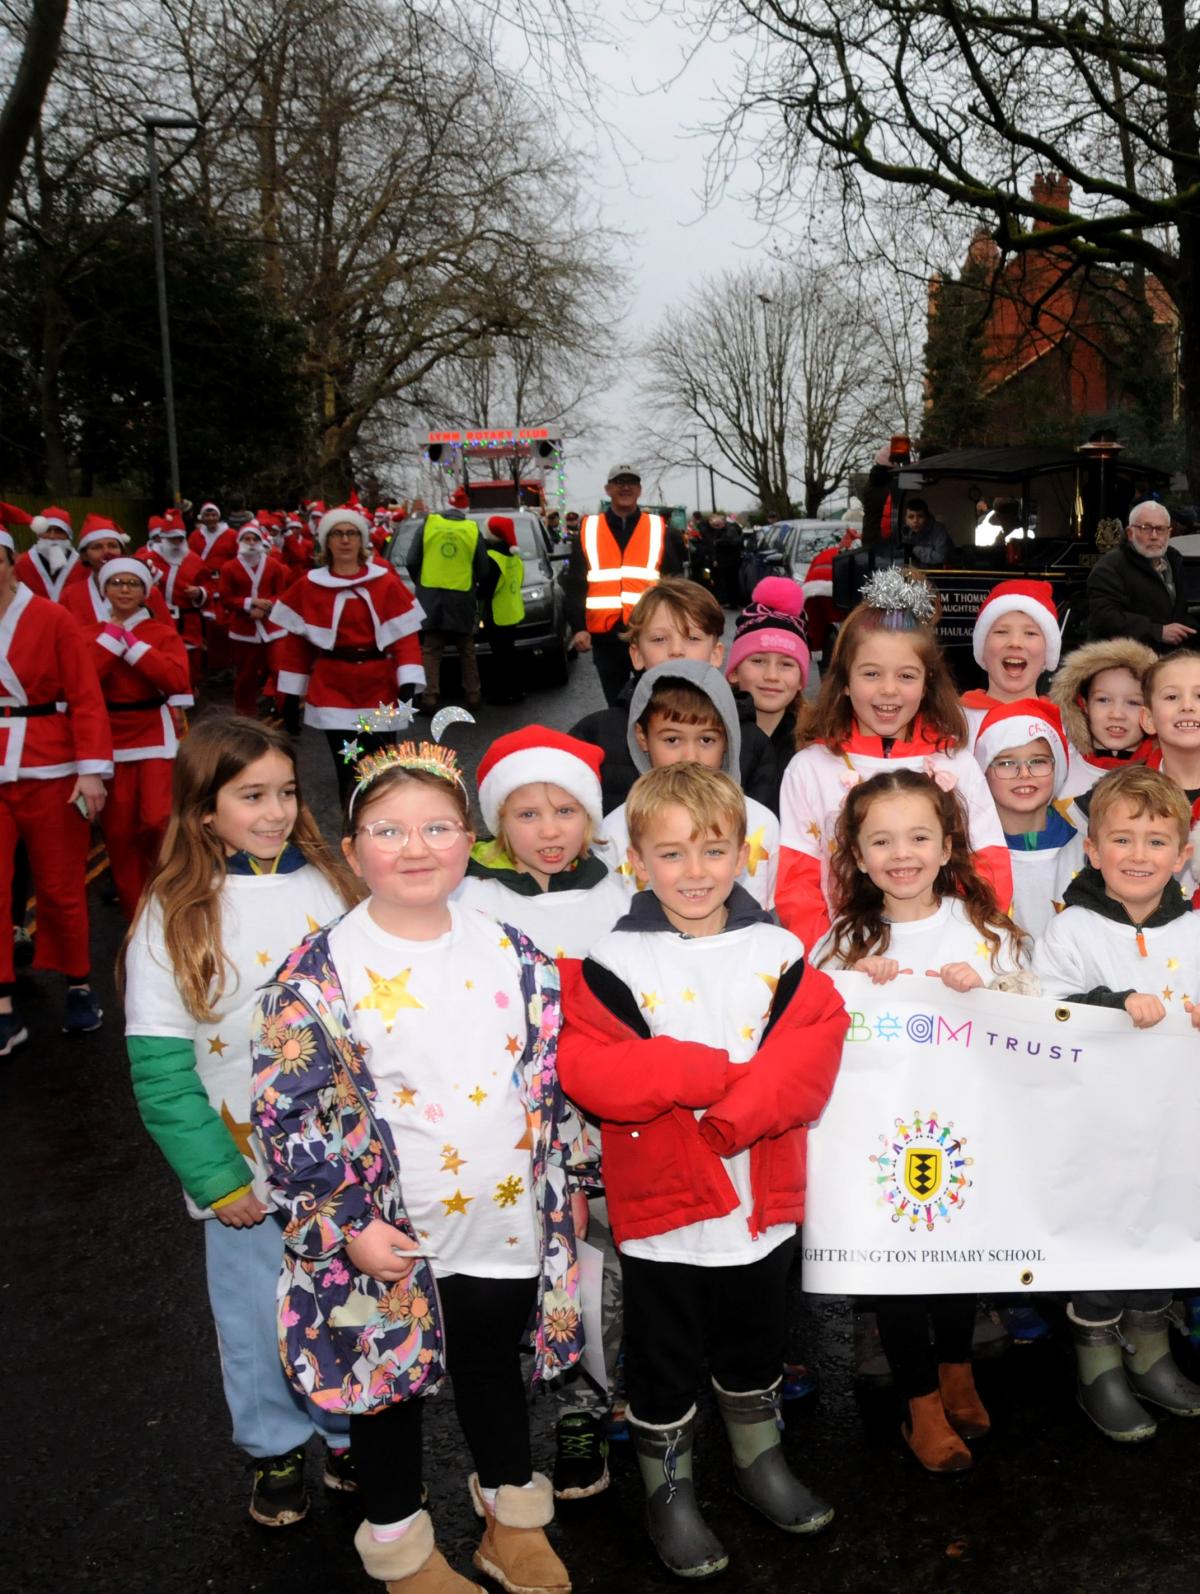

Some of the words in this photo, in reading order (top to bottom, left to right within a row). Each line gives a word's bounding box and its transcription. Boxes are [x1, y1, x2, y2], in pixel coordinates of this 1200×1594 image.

[429, 432, 461, 443] LYMM
[466, 430, 513, 440] ROTARY
[519, 427, 548, 438] CLUB
[941, 604, 979, 613] AUGHTERS
[941, 626, 973, 636] HAULAG
[986, 1032, 1083, 1063] TRUST
[802, 1248, 917, 1263] GHTRINGTON
[921, 1248, 986, 1262] PRIMARY
[988, 1248, 1046, 1262] SCHOOL
